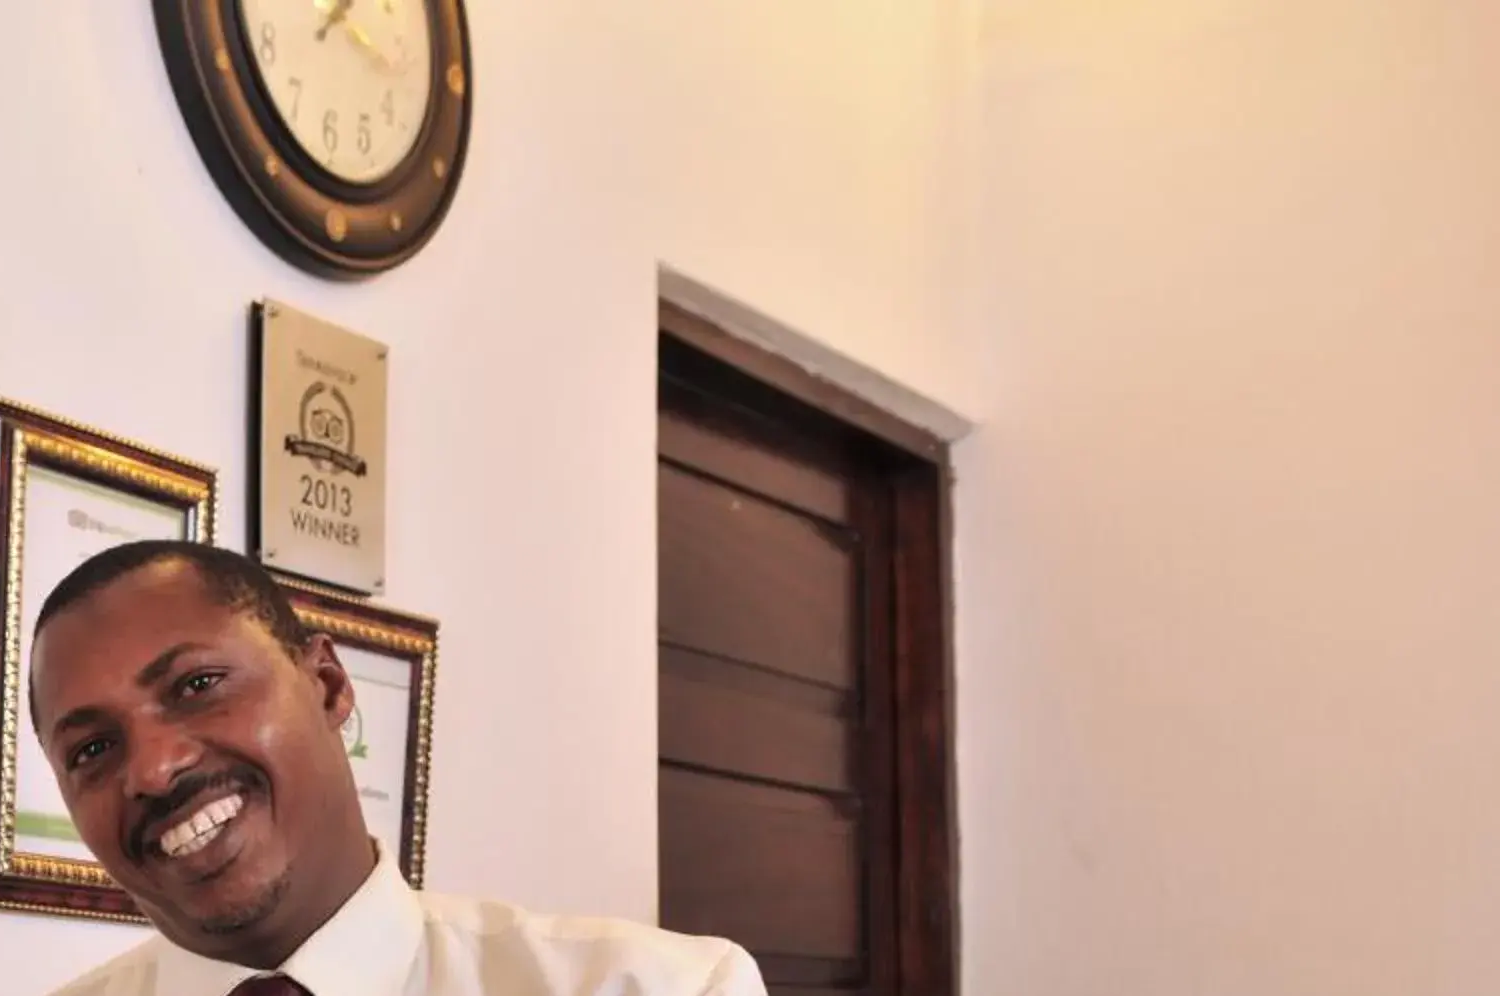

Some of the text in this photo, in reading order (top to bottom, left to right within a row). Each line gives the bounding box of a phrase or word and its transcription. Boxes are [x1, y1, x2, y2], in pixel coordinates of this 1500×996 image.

[259, 21, 275, 66] 8
[288, 76, 303, 122] 7
[322, 107, 338, 153] 6
[356, 112, 372, 156] 5
[300, 474, 352, 517] 2013
[290, 508, 361, 547] WINNER
